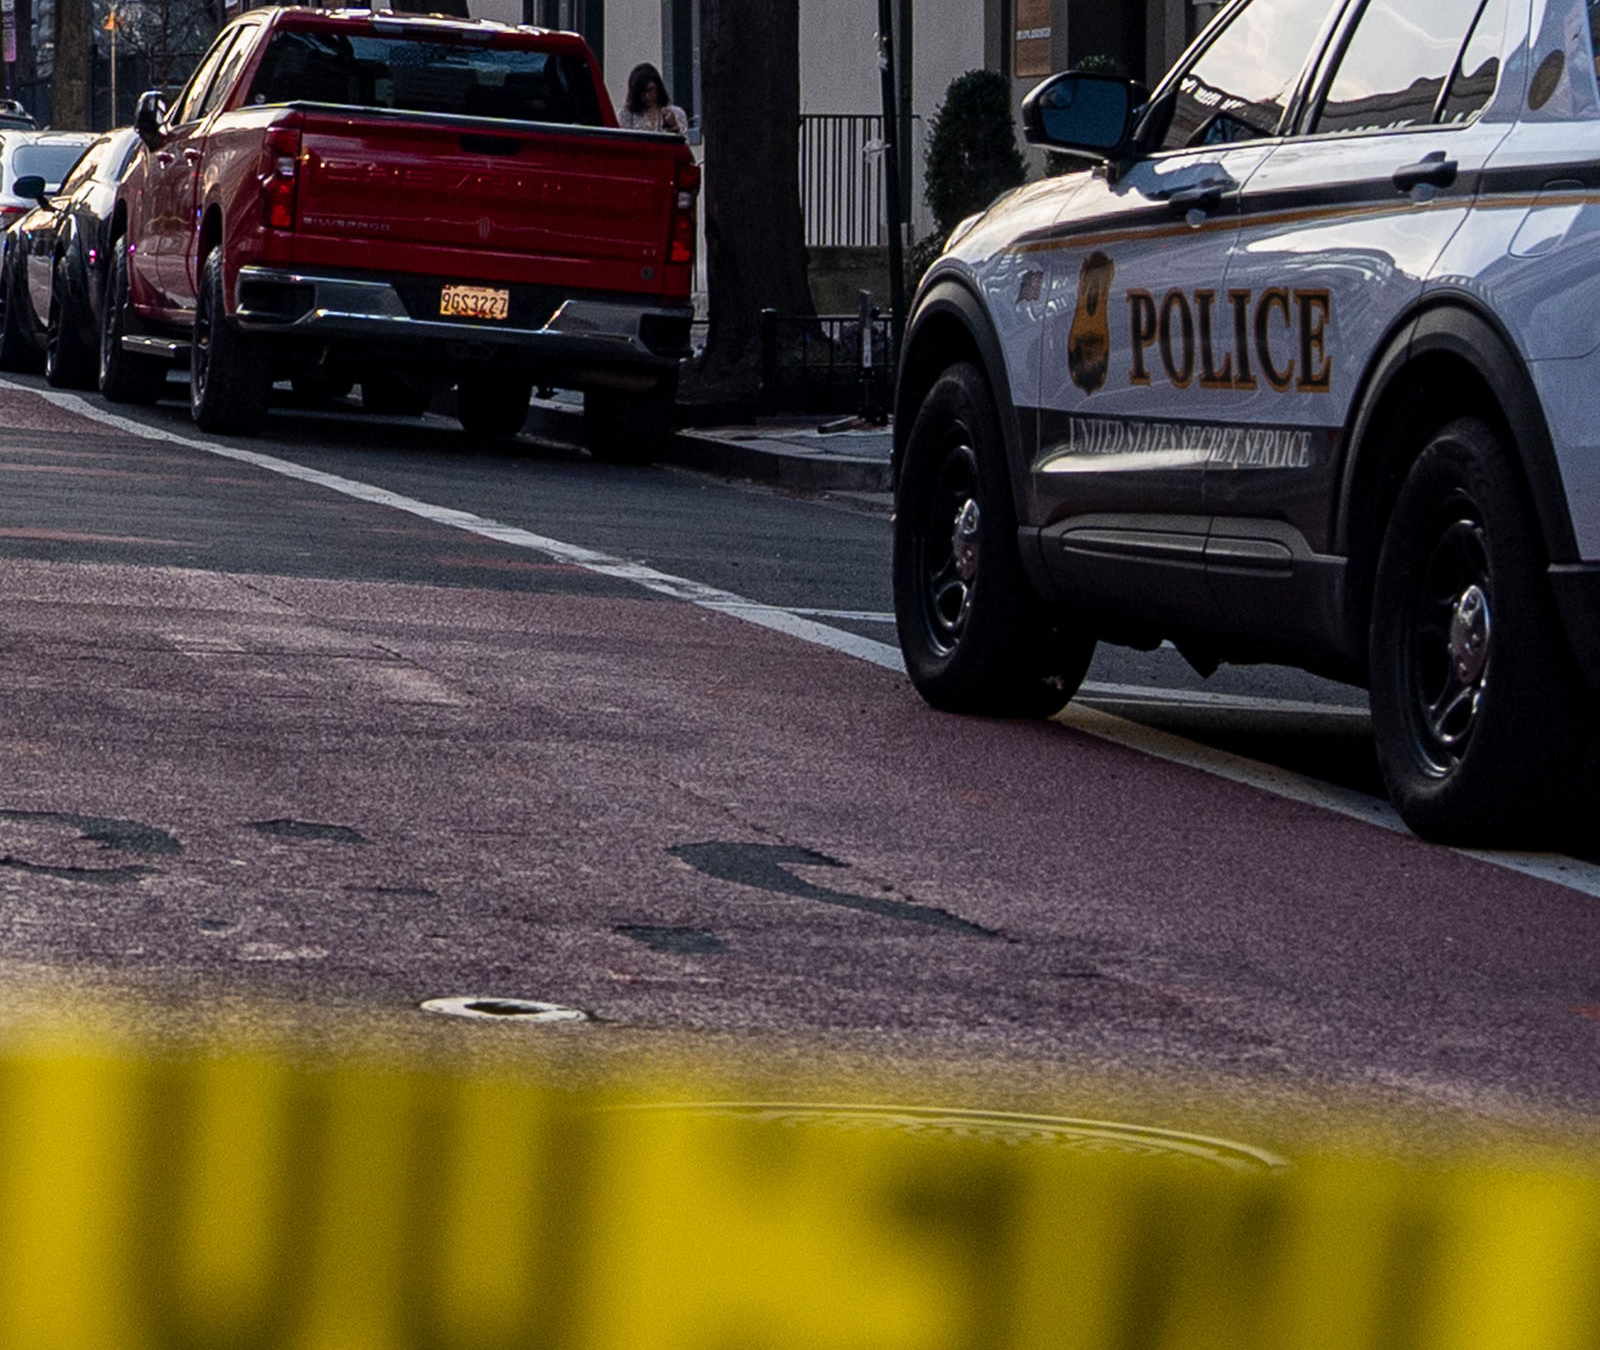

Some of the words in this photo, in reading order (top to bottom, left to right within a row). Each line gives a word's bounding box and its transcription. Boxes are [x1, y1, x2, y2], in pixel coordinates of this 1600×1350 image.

[442, 291, 507, 316] 9GS3227
[1126, 286, 1332, 393] POLICE
[1069, 417, 1125, 452] UNITED
[1126, 421, 1182, 453] STATES
[1182, 424, 1239, 464] SECRET
[1238, 430, 1312, 468] SERVICE
